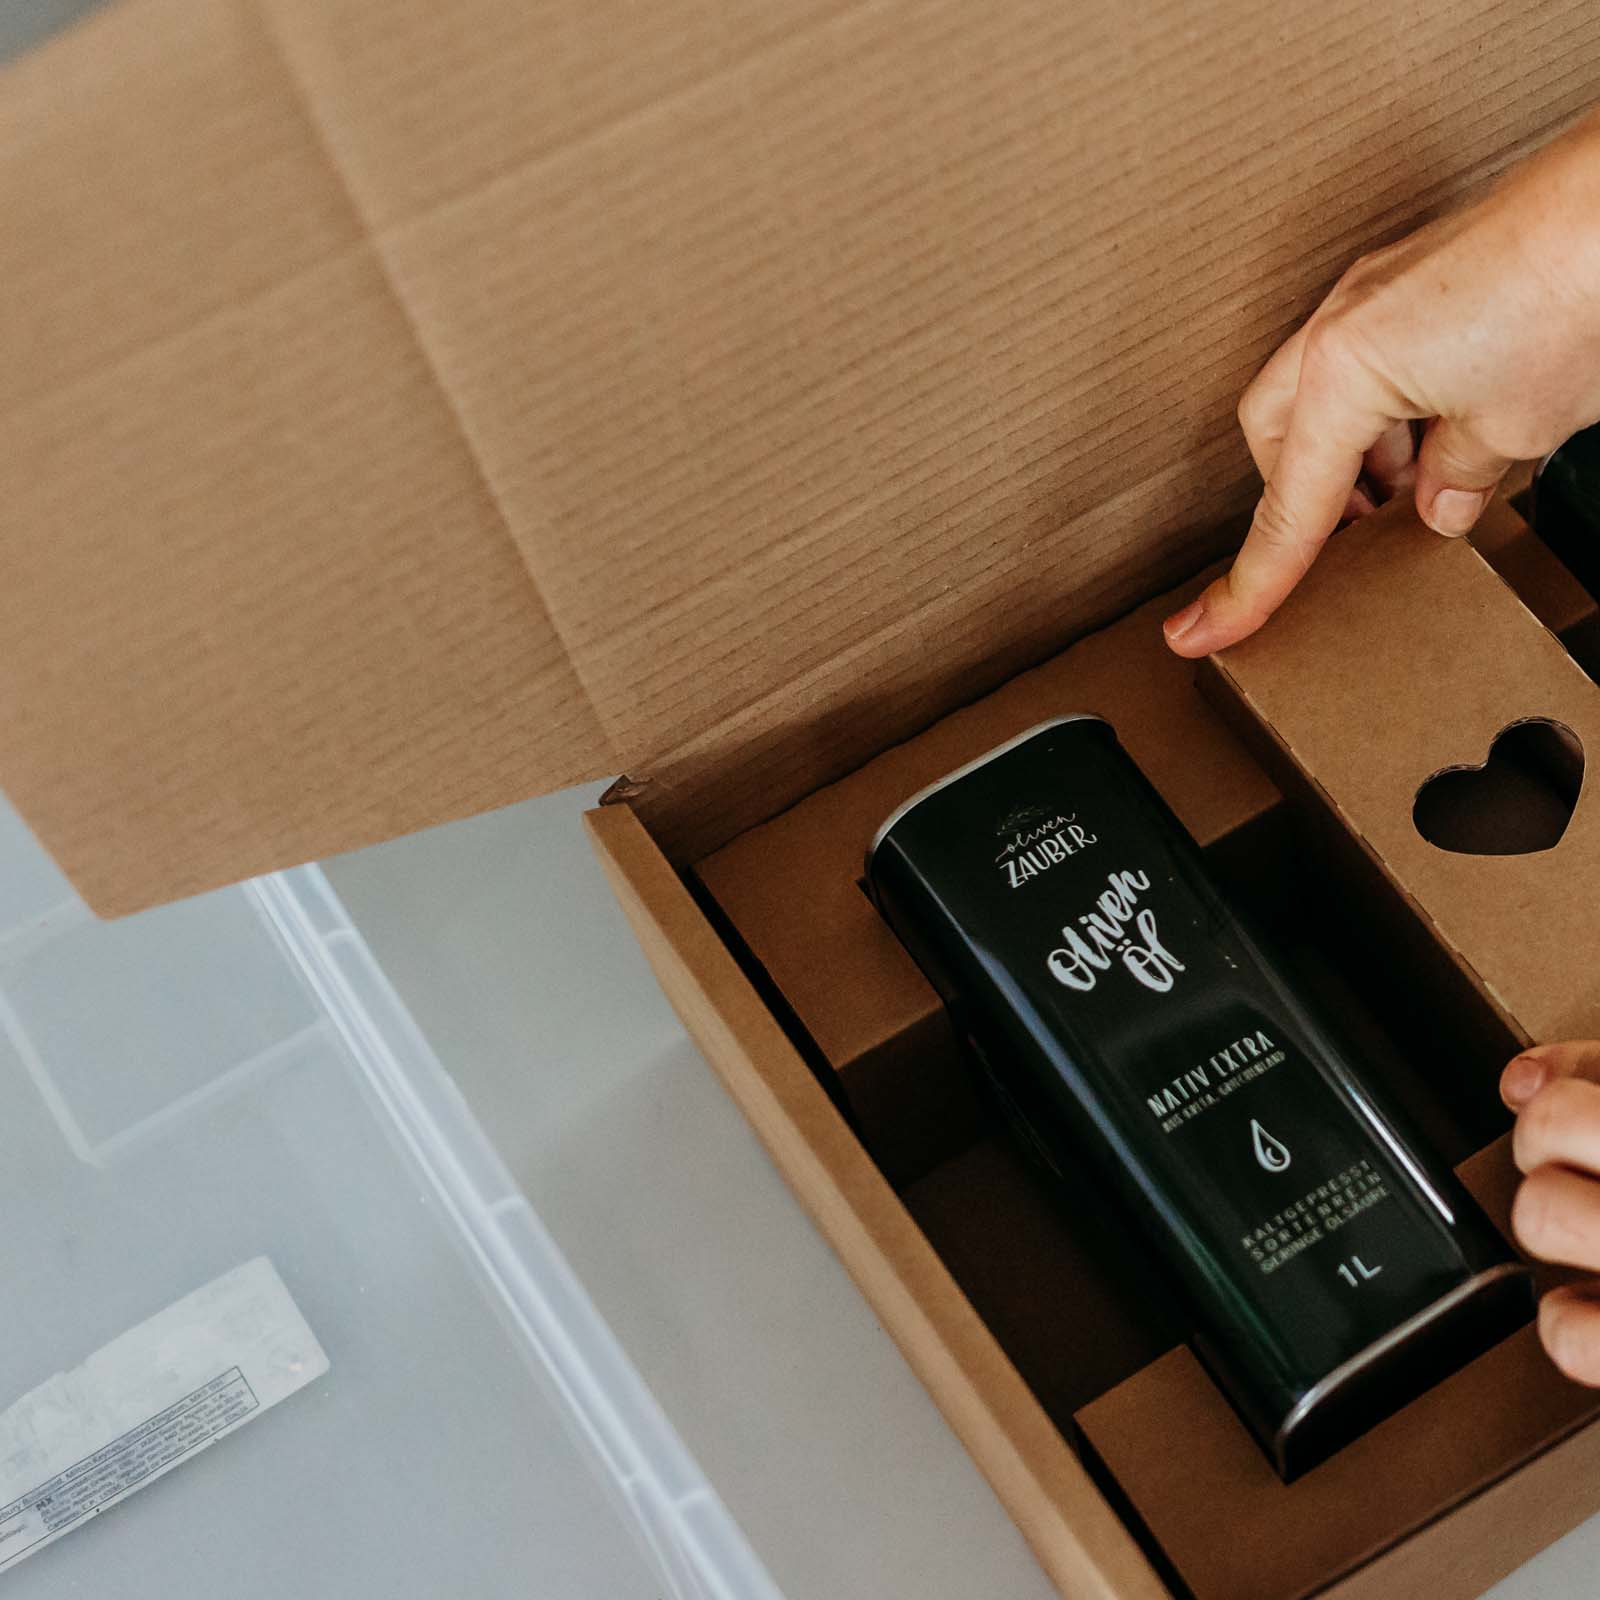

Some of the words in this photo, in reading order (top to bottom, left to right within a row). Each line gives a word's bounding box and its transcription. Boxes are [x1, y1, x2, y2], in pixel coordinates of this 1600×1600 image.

[998, 825, 1098, 889] ZAUBER
[1147, 1064, 1212, 1119] NATIV
[1208, 1030, 1275, 1079] EXTRA
[1241, 1159, 1373, 1250] KALTGEPRESST
[1250, 1170, 1383, 1261] SORTENREIN
[1337, 1255, 1383, 1288] 1L
